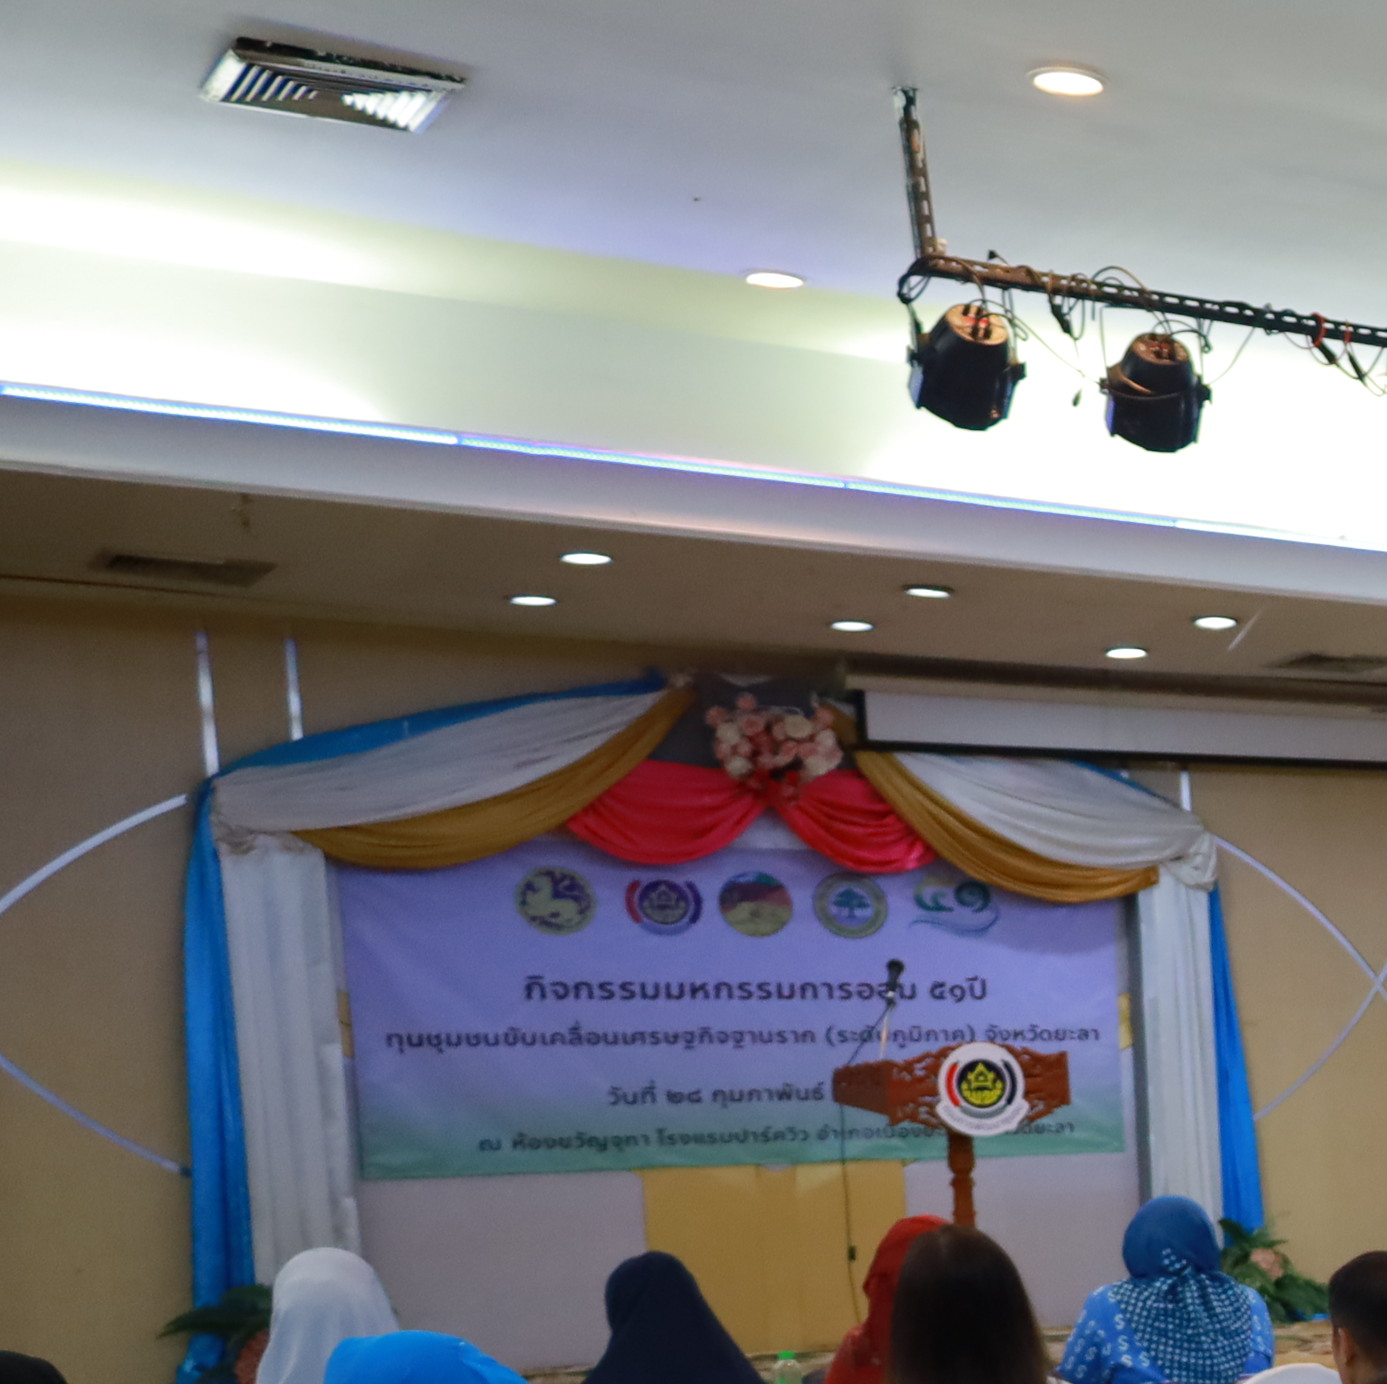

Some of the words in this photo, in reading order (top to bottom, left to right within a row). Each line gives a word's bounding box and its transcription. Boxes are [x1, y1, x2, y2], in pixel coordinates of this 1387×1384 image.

[524, 974, 917, 1002] กิจกรรมมหกรรมการออม
[930, 975, 988, 1003] ๕๑ปี
